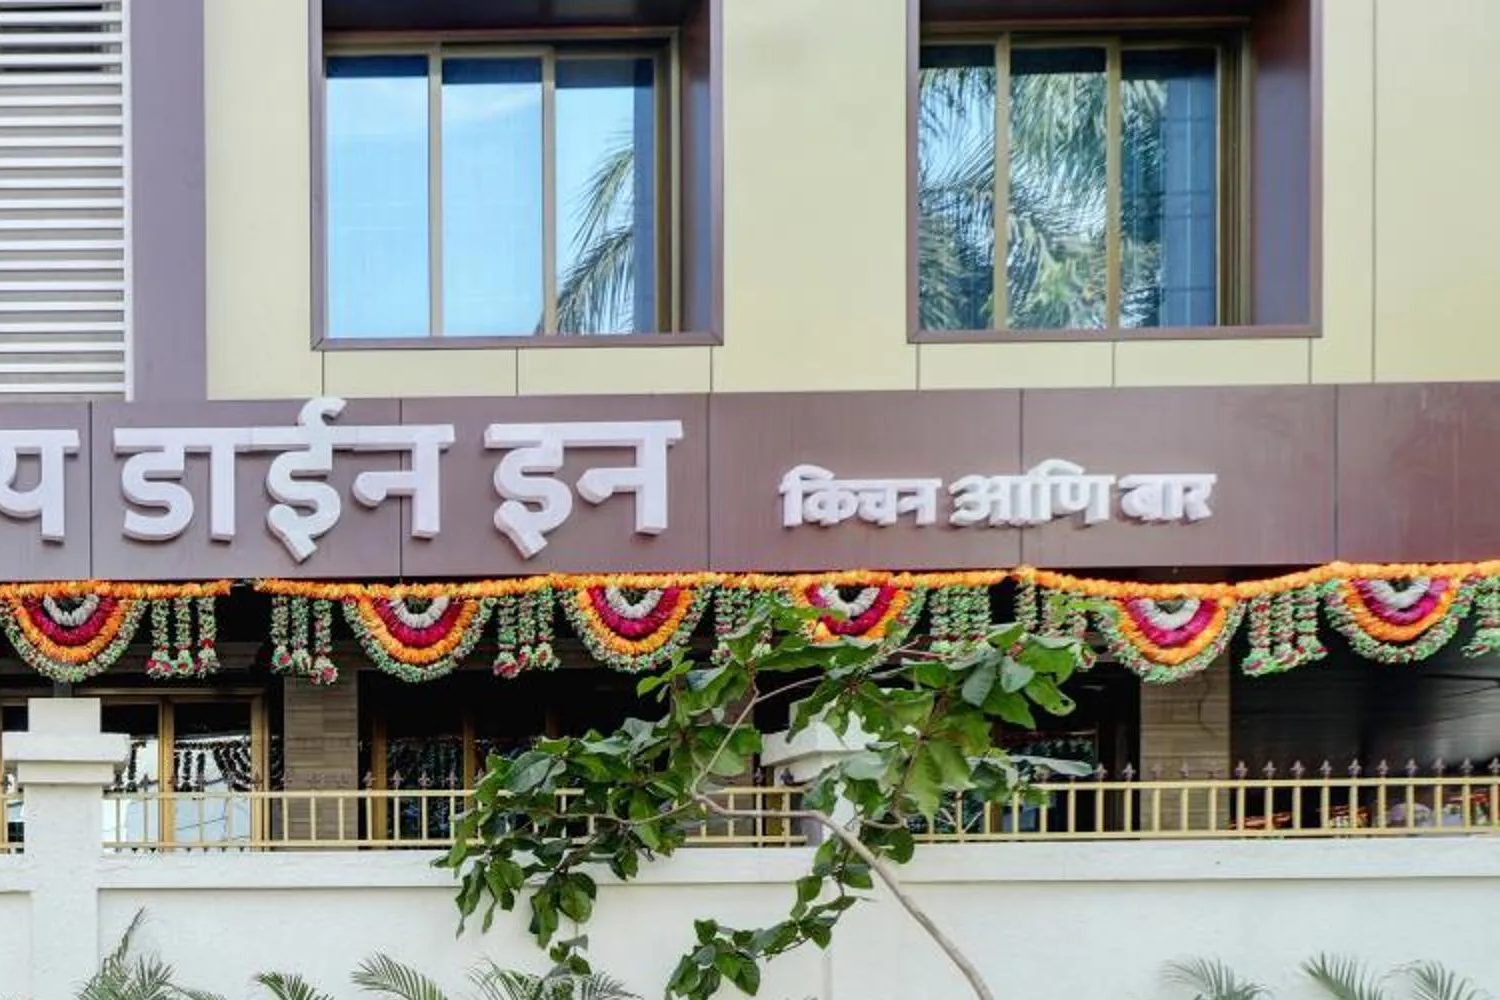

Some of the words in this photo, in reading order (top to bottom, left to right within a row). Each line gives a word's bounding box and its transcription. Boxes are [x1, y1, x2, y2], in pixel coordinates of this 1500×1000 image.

[114, 397, 455, 562] डाईन
[484, 420, 684, 559] इन
[779, 464, 943, 527] किचन
[948, 458, 1117, 526] आणि
